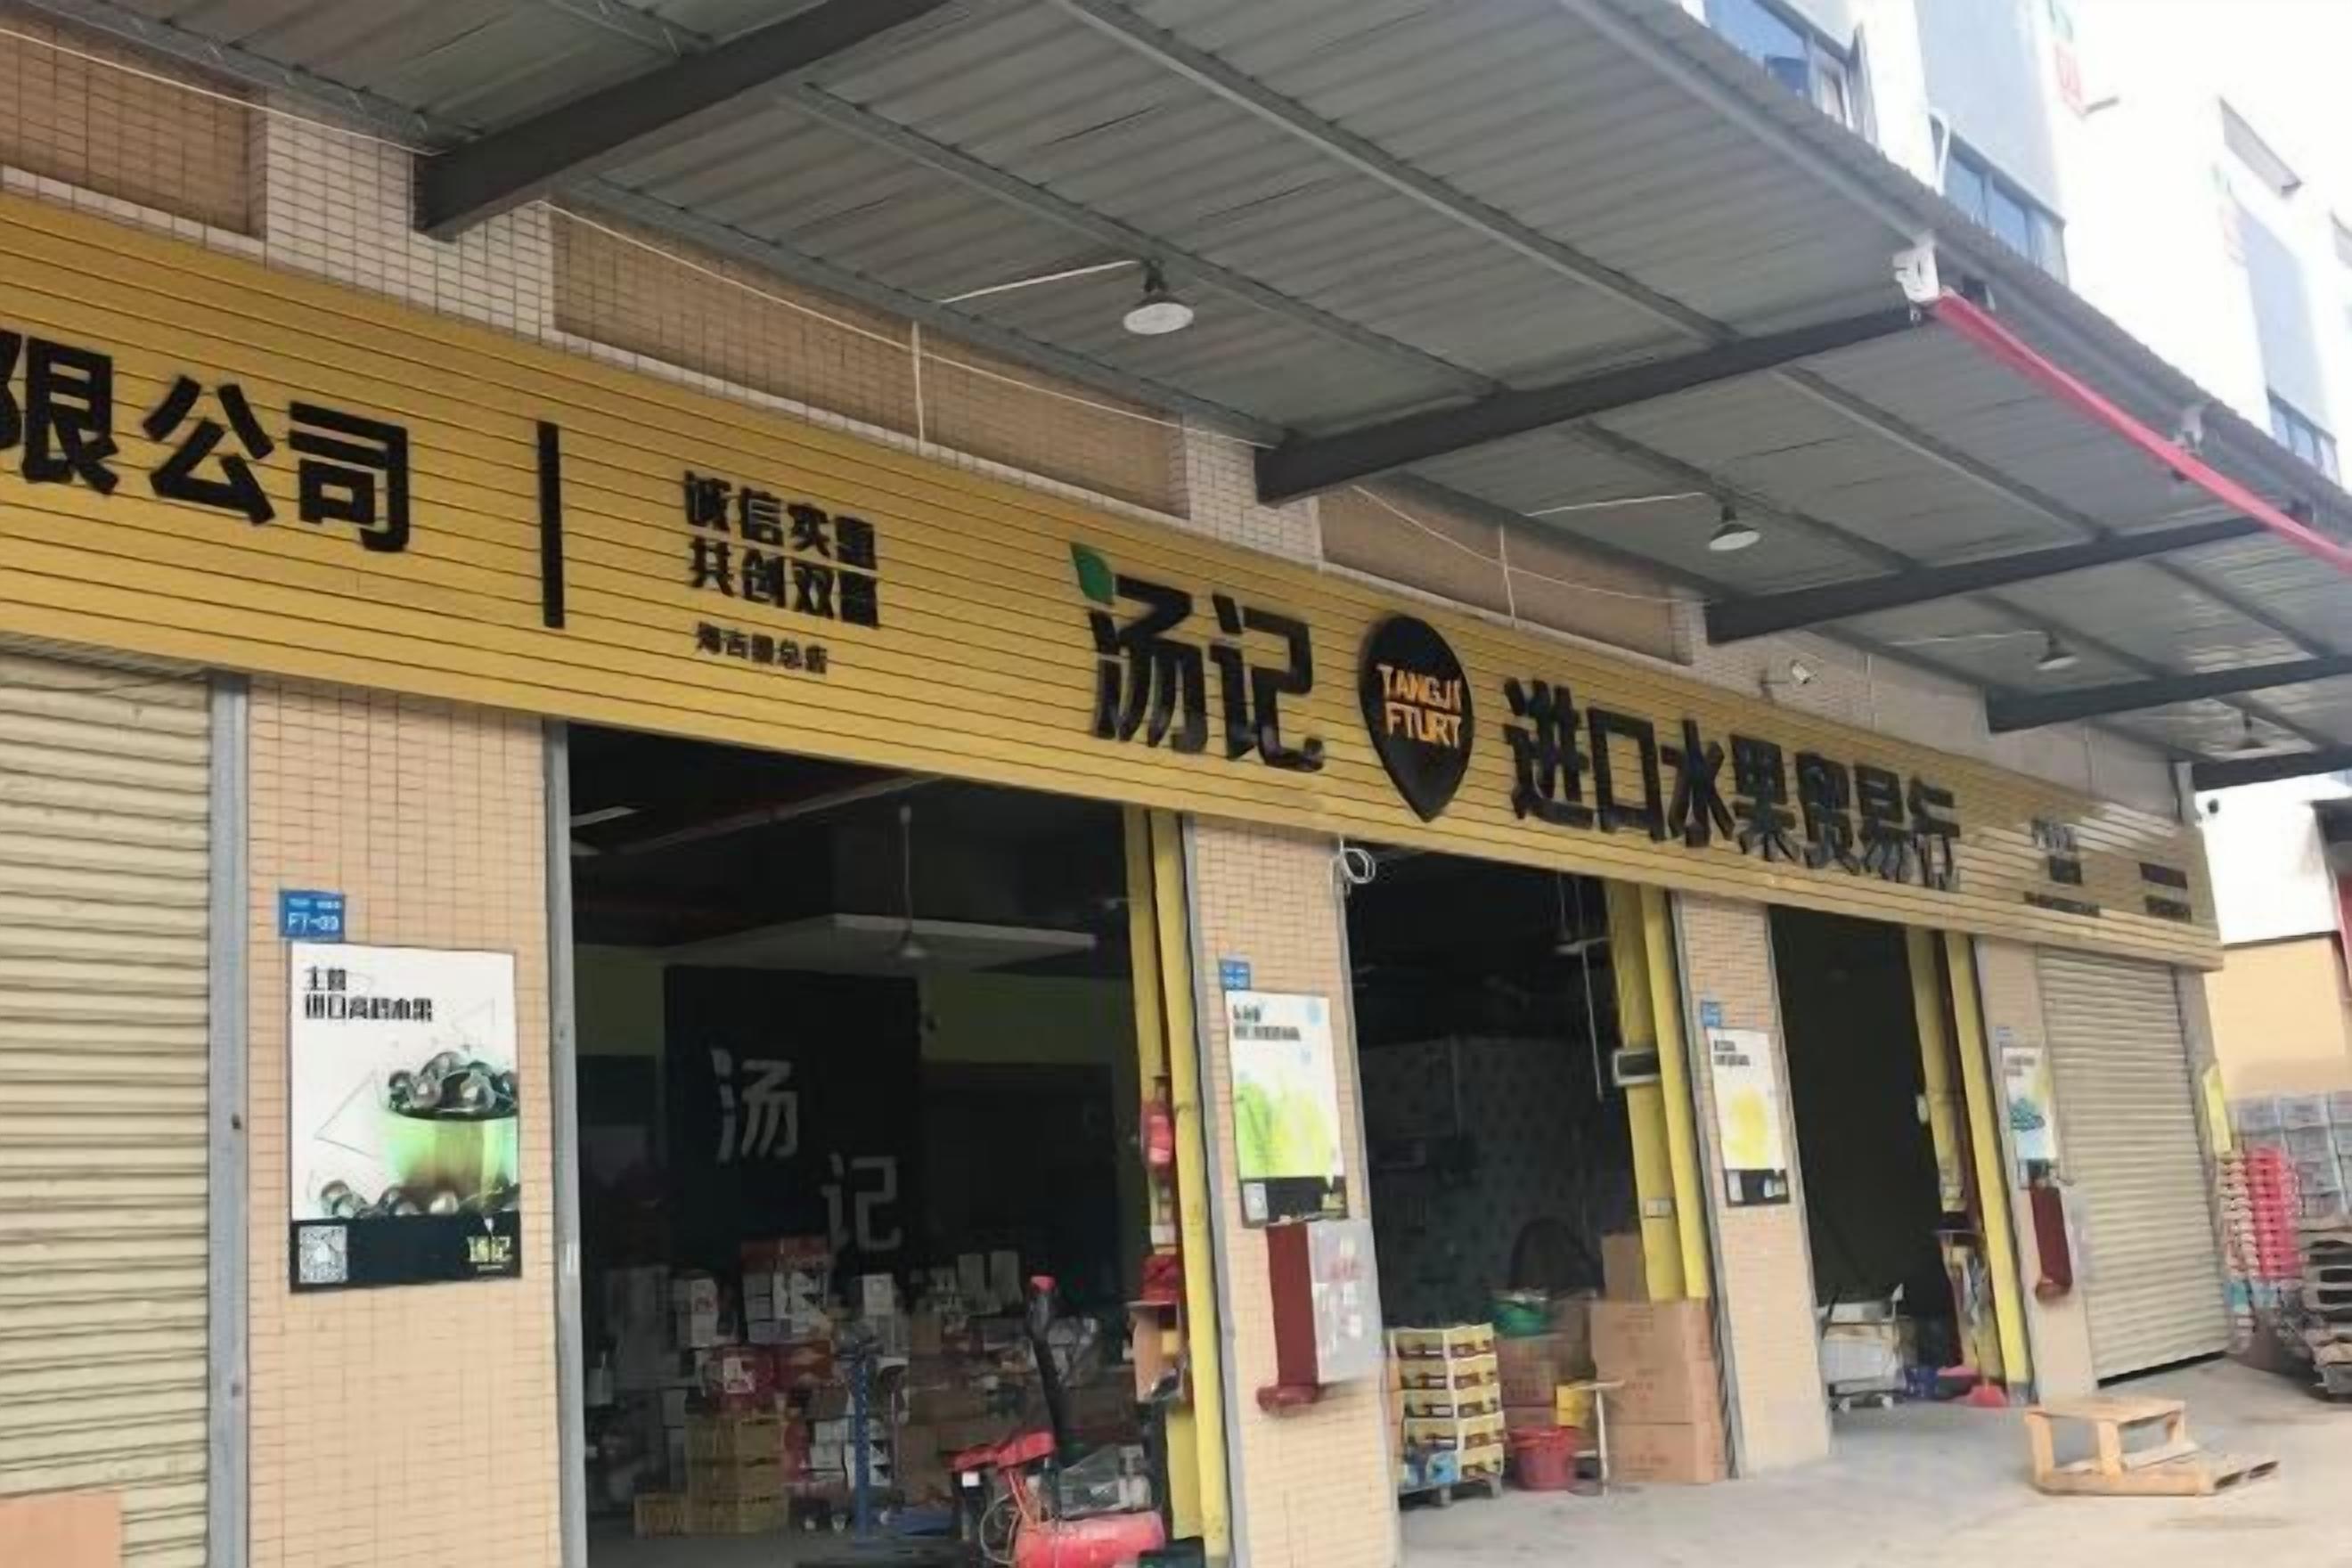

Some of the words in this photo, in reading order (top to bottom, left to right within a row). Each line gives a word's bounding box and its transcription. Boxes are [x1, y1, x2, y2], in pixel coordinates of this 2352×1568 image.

[1070, 542, 1325, 772] 汤记
[1502, 675, 1961, 892] 进口水果贸易行
